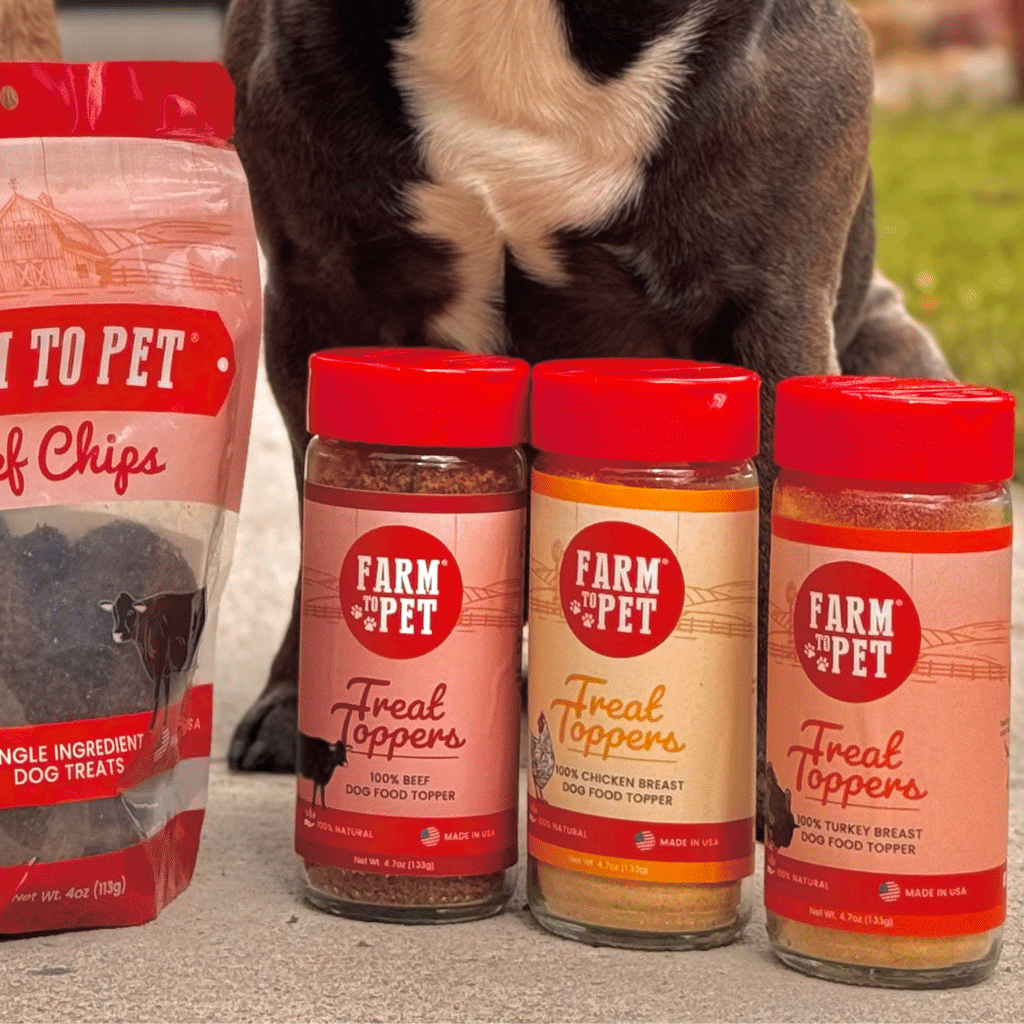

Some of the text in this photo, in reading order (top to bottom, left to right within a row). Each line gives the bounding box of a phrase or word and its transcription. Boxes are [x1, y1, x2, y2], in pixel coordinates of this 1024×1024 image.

[31, 327, 85, 387] TO
[96, 325, 185, 389] PET
[37, 420, 166, 495] Chips
[357, 555, 440, 595] FARM
[576, 549, 661, 595] FARM
[362, 595, 437, 635] TO PET
[581, 590, 657, 635] TO PET
[809, 590, 894, 637] FARM
[815, 633, 892, 678] TO PET
[346, 677, 447, 721] Treat
[564, 673, 666, 722] Treat
[330, 702, 466, 761] Toppers
[550, 698, 686, 760] Toppers
[53, 733, 145, 761] INGREDIENT
[800, 719, 904, 769] Treat
[14, 758, 125, 786] DOG TREATS
[370, 772, 430, 786] 100% BEEF
[555, 764, 684, 791] 100% CHICKEN BREAST
[787, 745, 928, 809] Toppers
[346, 784, 455, 801] DOG FOOD TOPPER
[562, 781, 673, 805] DOG FOOD TOPPER
[335, 825, 374, 839] NATURAL
[444, 829, 496, 841] MADE IN USA
[553, 822, 587, 839] NATURAL
[796, 814, 923, 839] 100% TURKEY BREAST
[660, 838, 719, 847] MADE IN USA
[801, 831, 916, 855] DOG FOOD TOPPER
[42, 889, 61, 902] Wt.
[65, 887, 90, 899] 4oz
[94, 875, 126, 899] (113g)
[792, 874, 829, 890] NATURAL
[905, 887, 967, 898] MADE IN USA
[809, 907, 823, 917] Net
[839, 911, 862, 924] 4.7oz
